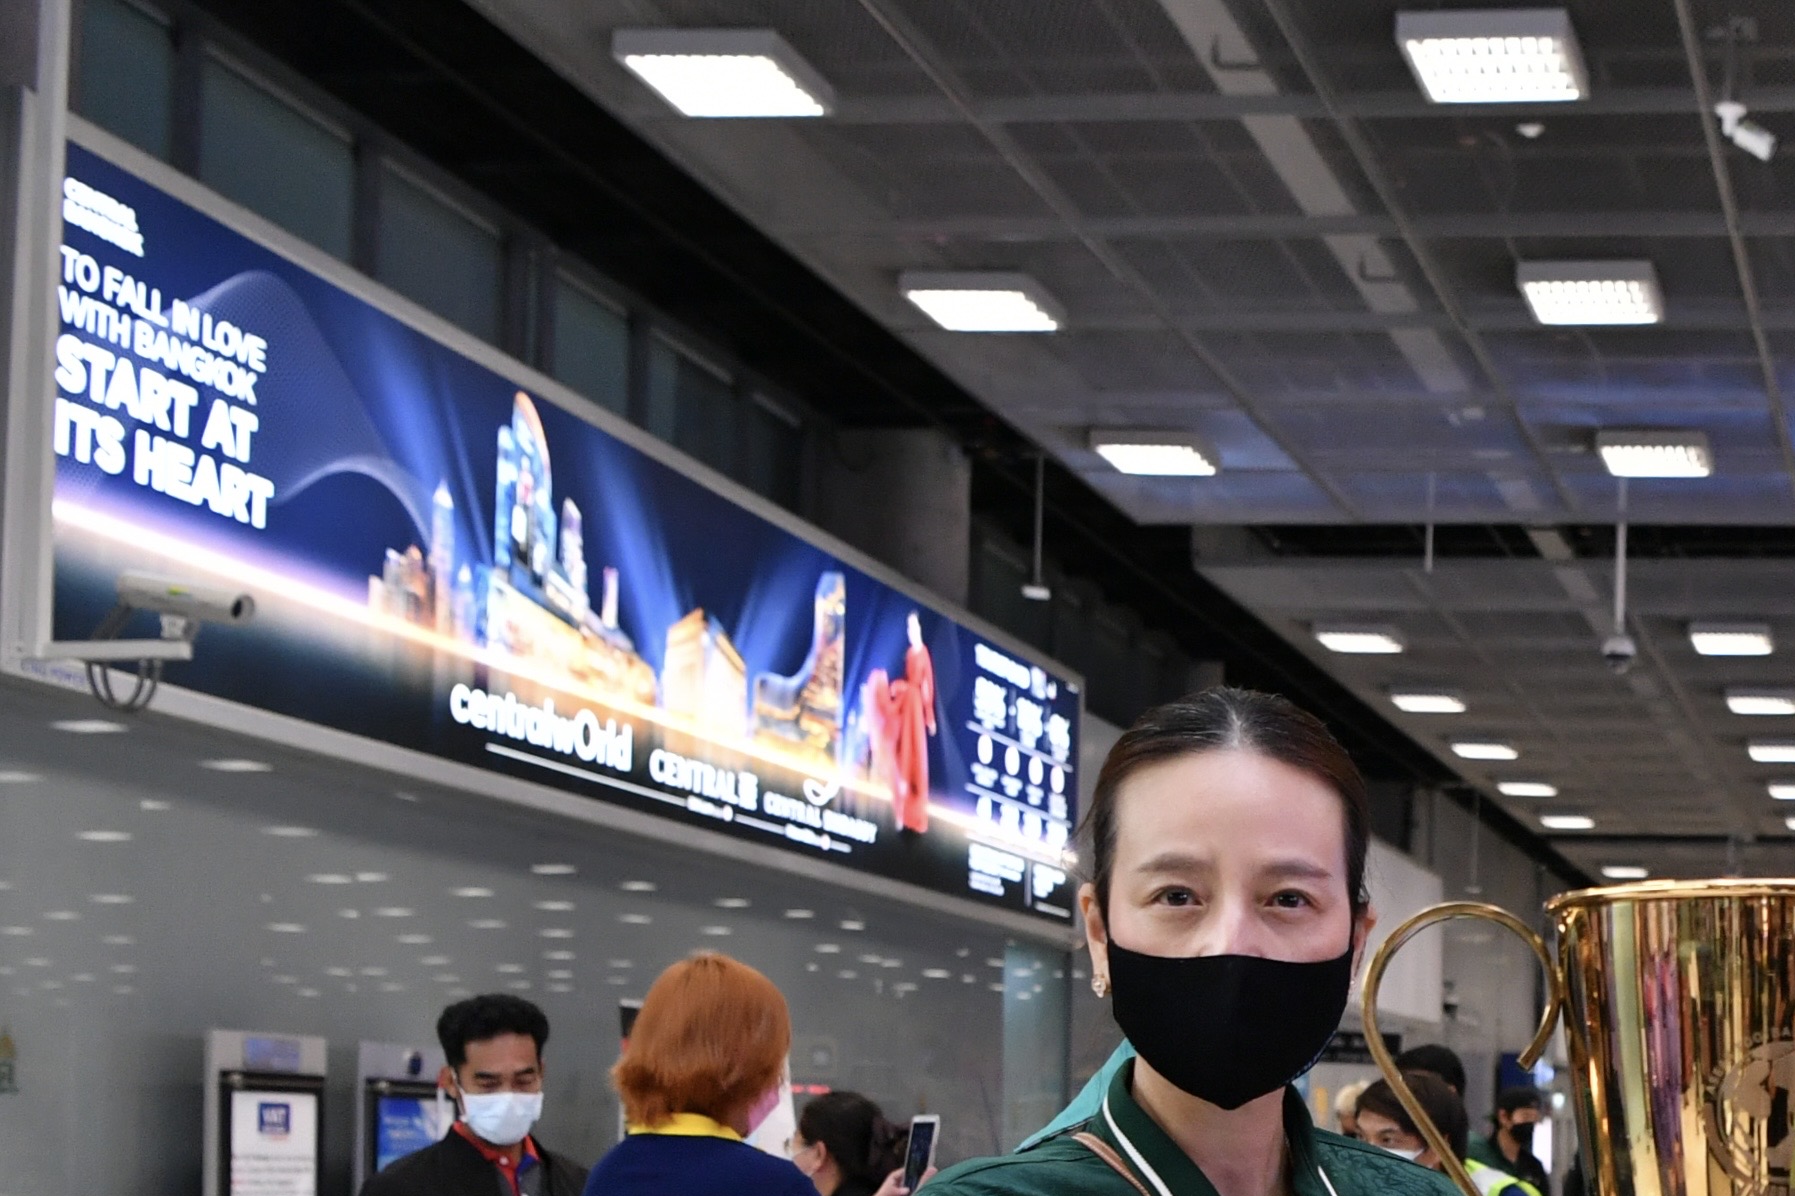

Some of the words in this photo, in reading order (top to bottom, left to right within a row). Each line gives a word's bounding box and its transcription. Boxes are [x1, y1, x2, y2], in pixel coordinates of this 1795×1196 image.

[58, 285, 131, 348] WITH
[135, 318, 257, 404] BANGKOK
[60, 244, 100, 292] TO
[104, 266, 168, 326] FALL
[173, 297, 200, 339] IN
[202, 310, 267, 373] LOVE
[55, 334, 198, 437] START
[201, 400, 258, 461] AT
[54, 397, 126, 475] ITS
[133, 428, 274, 529] HEART
